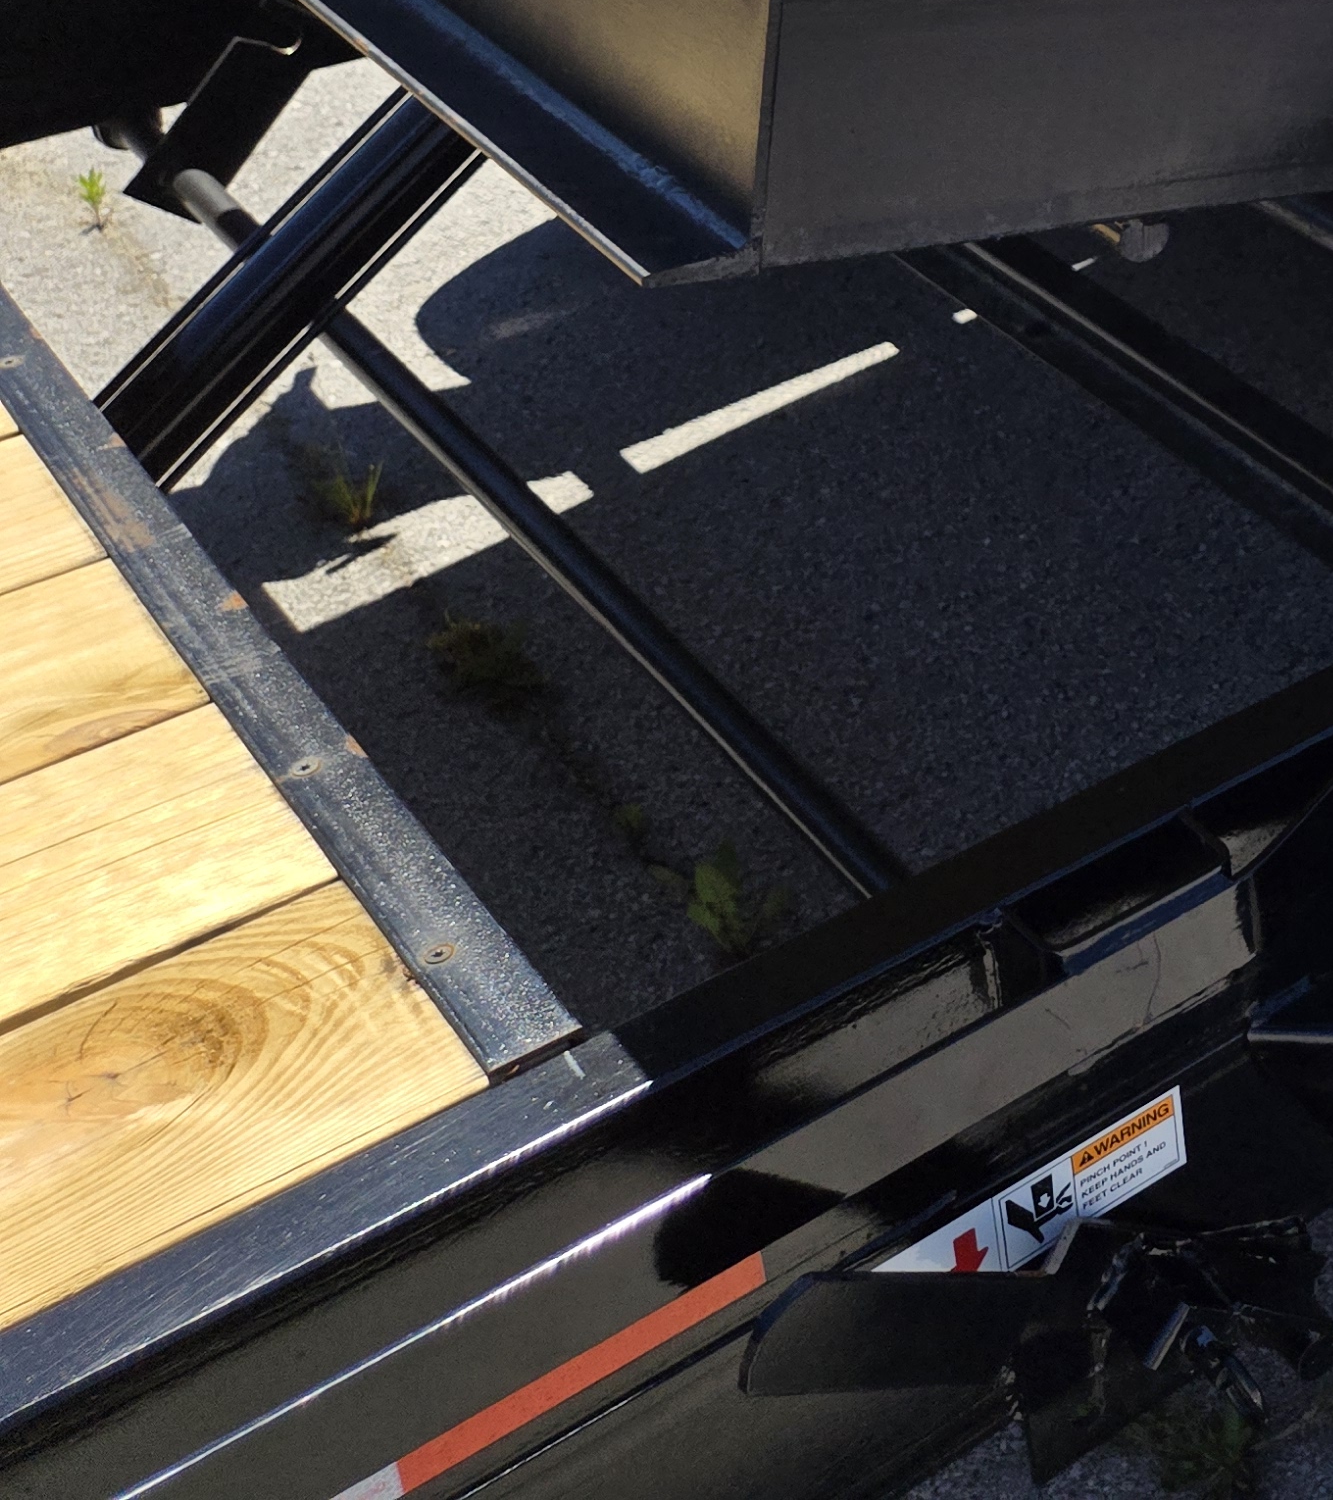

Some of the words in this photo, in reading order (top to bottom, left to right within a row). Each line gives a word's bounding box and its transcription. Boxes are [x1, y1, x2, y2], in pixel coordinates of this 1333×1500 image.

[1093, 1103, 1170, 1156] WARNING
[1080, 1163, 1110, 1187] PINCH
[1113, 1144, 1141, 1167] POINT
[1081, 1177, 1108, 1198] KEEP
[1110, 1155, 1144, 1182] HANDS
[1146, 1141, 1167, 1158] AND
[1082, 1189, 1108, 1210] FEET
[1110, 1167, 1143, 1192] CLEAR
